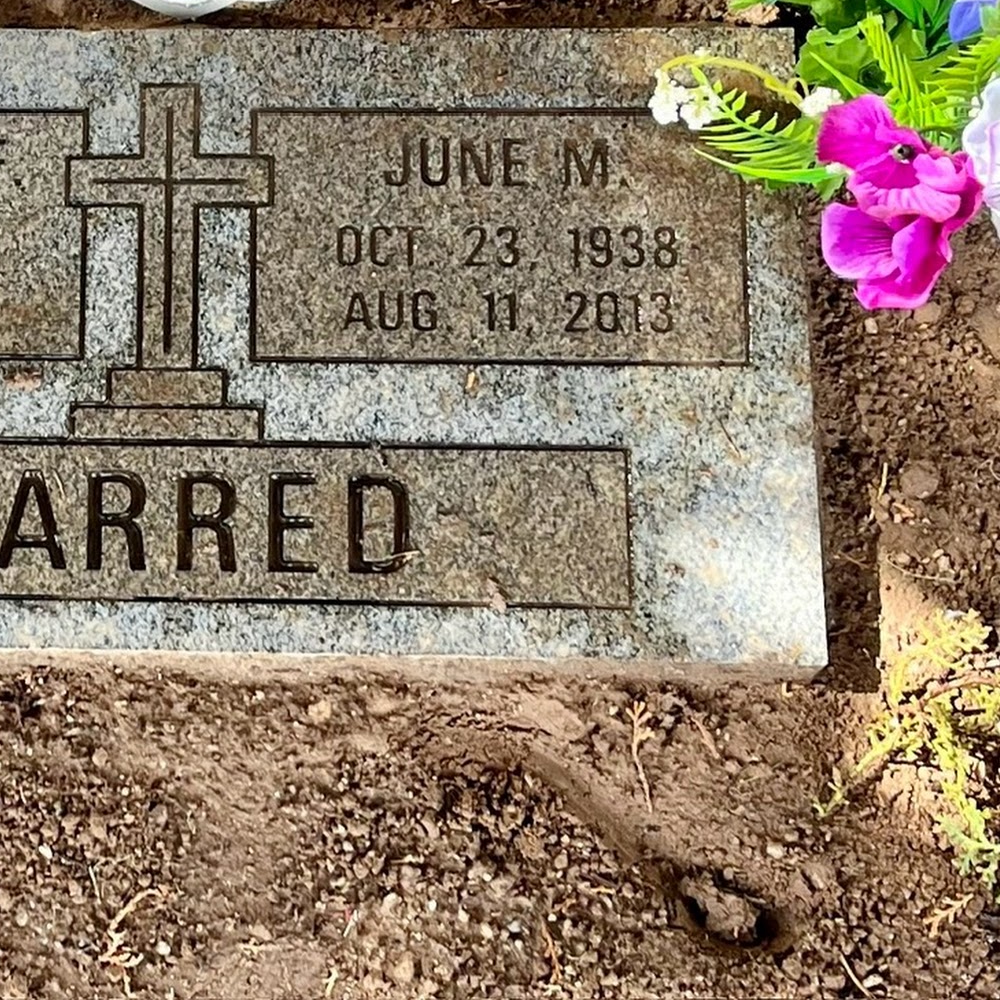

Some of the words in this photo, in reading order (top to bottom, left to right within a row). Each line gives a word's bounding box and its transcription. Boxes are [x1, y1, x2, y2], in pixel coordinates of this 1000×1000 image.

[383, 136, 527, 188] JUNE
[562, 136, 631, 189] M.
[462, 224, 537, 271] 23,
[568, 225, 680, 269] 1938
[485, 290, 534, 337] 11,
[563, 290, 676, 334] 2013
